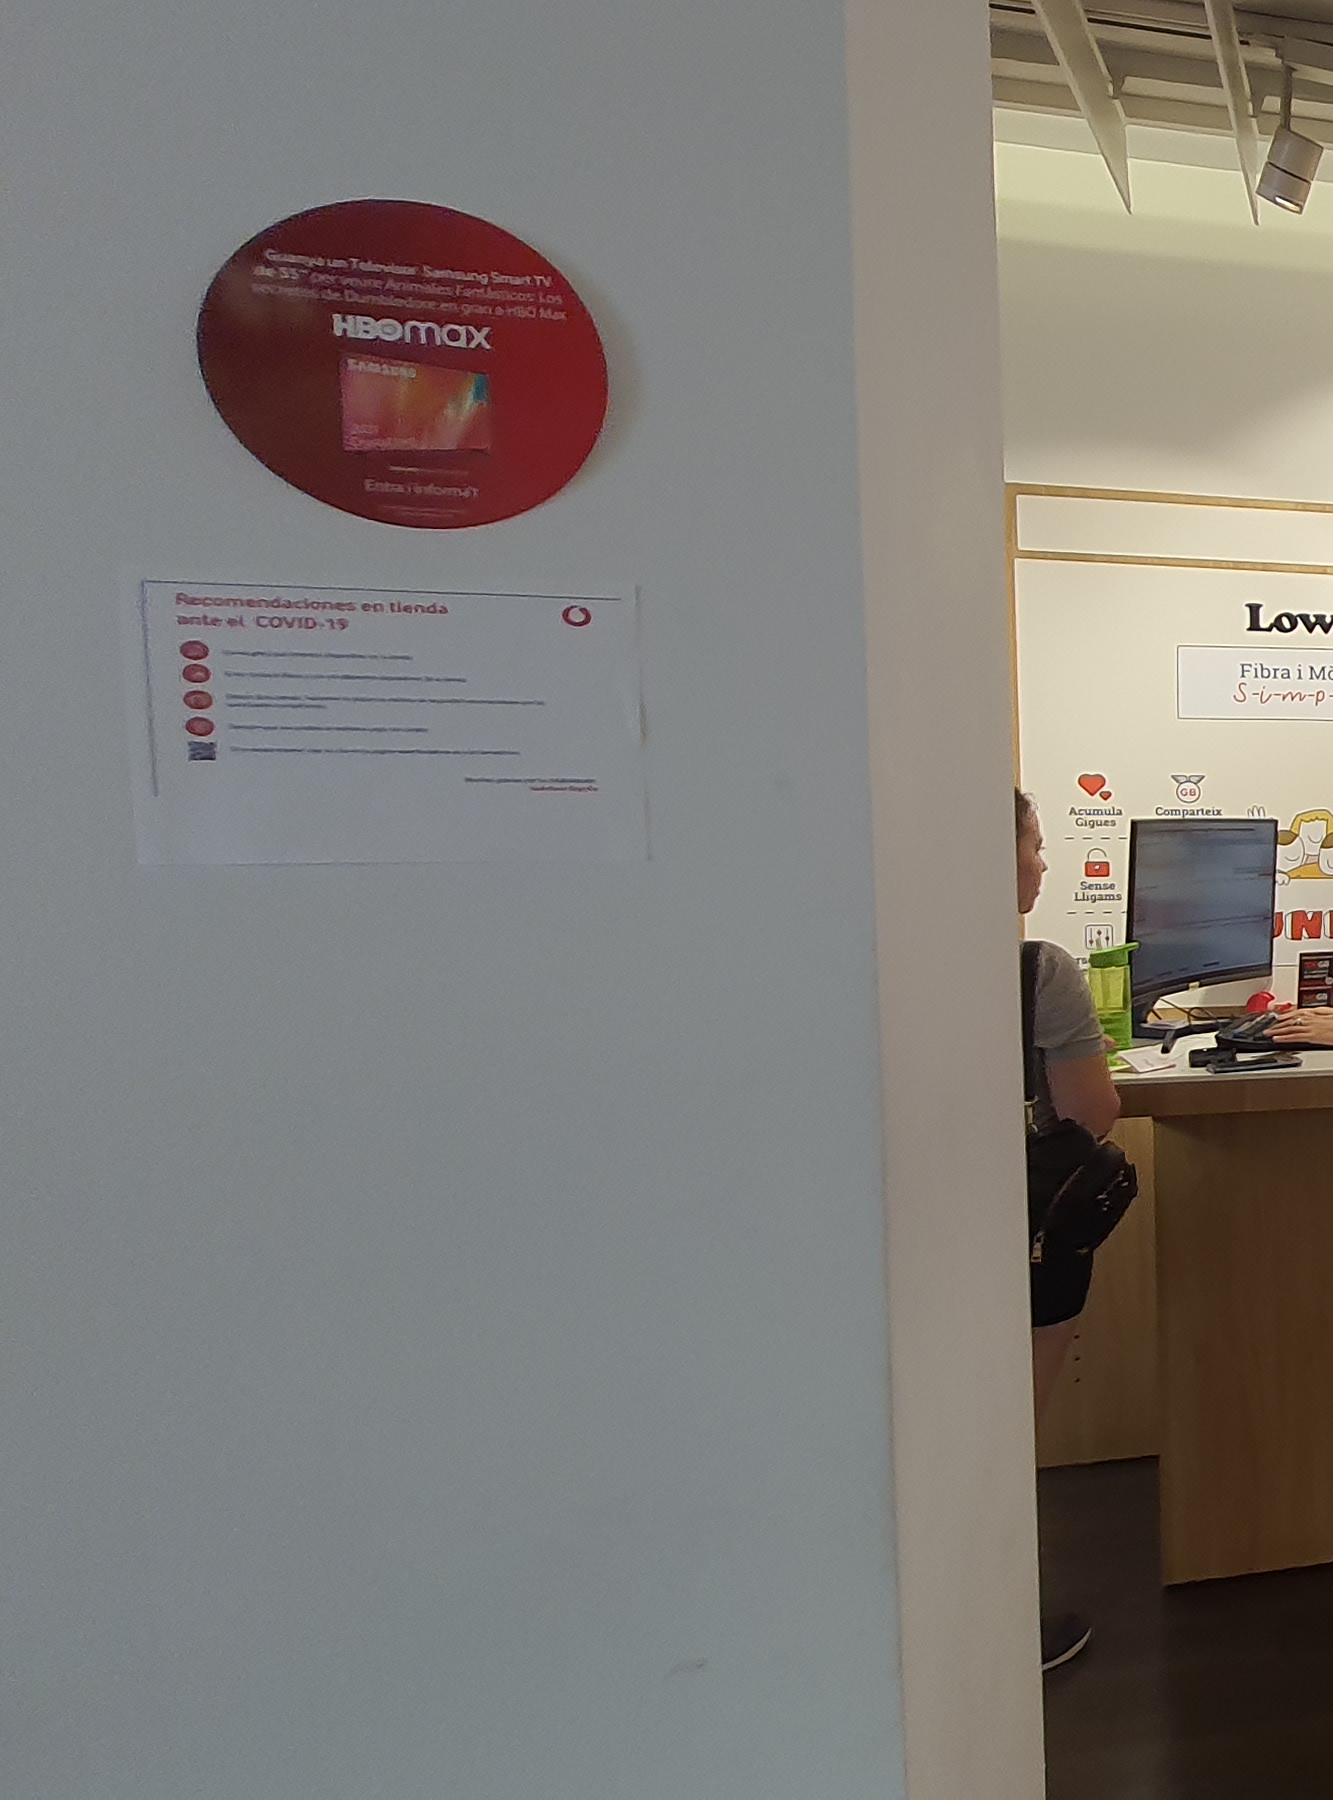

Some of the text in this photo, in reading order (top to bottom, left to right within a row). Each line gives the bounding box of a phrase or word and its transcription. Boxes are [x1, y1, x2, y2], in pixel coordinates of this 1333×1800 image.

[422, 264, 489, 286] Samsung
[490, 271, 532, 285] Smart
[533, 274, 551, 287] TV
[538, 293, 563, 305] Los
[460, 303, 493, 316] gran
[505, 306, 536, 319] HBO
[538, 307, 568, 321] Max
[364, 479, 405, 494] Entra
[176, 592, 449, 615] Recomendaciones en tienda
[177, 614, 350, 631] ante el COVID-19
[1239, 663, 1291, 680] Fibra
[1297, 664, 1304, 680] i
[1180, 787, 1197, 797] GB
[1068, 806, 1123, 817] Acumula
[1155, 806, 1222, 818] Comparteix
[1075, 817, 1117, 828] Gigues
[1080, 881, 1116, 891] Sense
[1074, 891, 1123, 903] Lligams
